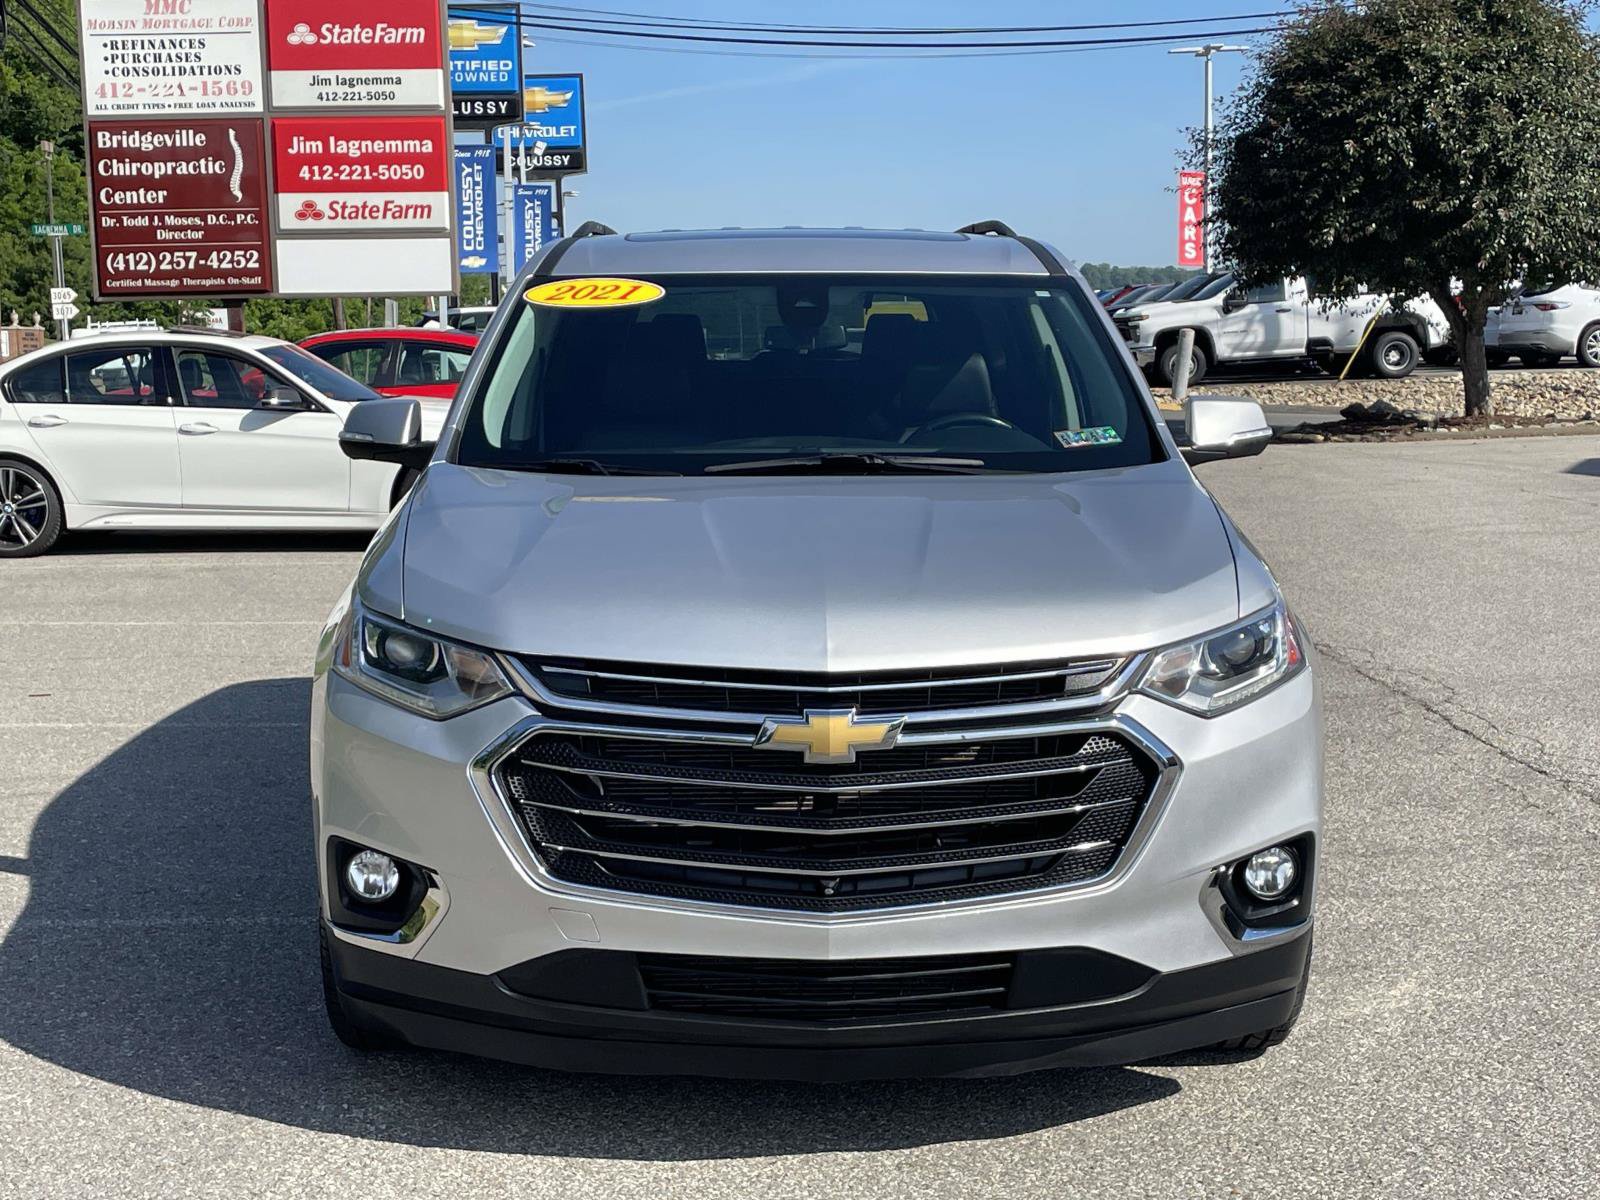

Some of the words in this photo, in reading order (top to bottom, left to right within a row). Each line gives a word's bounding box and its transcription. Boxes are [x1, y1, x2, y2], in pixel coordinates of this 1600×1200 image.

[143, 0, 192, 15] MMC
[142, 18, 213, 30] MORTGAGE
[94, 79, 254, 98] 412-221-1569
[309, 75, 331, 87] Jim
[335, 75, 402, 88] Iagnemma
[317, 91, 396, 102] 412-221-5050
[142, 102, 166, 110] TYPES
[97, 129, 207, 151] Bridgeville
[287, 136, 323, 154] Jim
[329, 136, 433, 157] Iagnemma
[98, 157, 226, 179] Chiropractic
[299, 164, 425, 181] 412-221-5050
[100, 187, 168, 205] Center
[462, 162, 474, 251] COLUSSY
[474, 162, 484, 251] CHEVROLET
[101, 216, 120, 227] Dr.
[121, 215, 149, 227] Todd
[152, 215, 162, 226] J.
[164, 214, 205, 227] Moses,
[236, 213, 259, 225] P.C.
[1183, 187, 1198, 259] CARS
[156, 229, 205, 240] Director
[106, 278, 142, 288] Certified
[144, 278, 180, 288] Massage
[182, 277, 225, 287] Therapists
[227, 276, 262, 285] On-Staff
[544, 284, 643, 301] 2021
